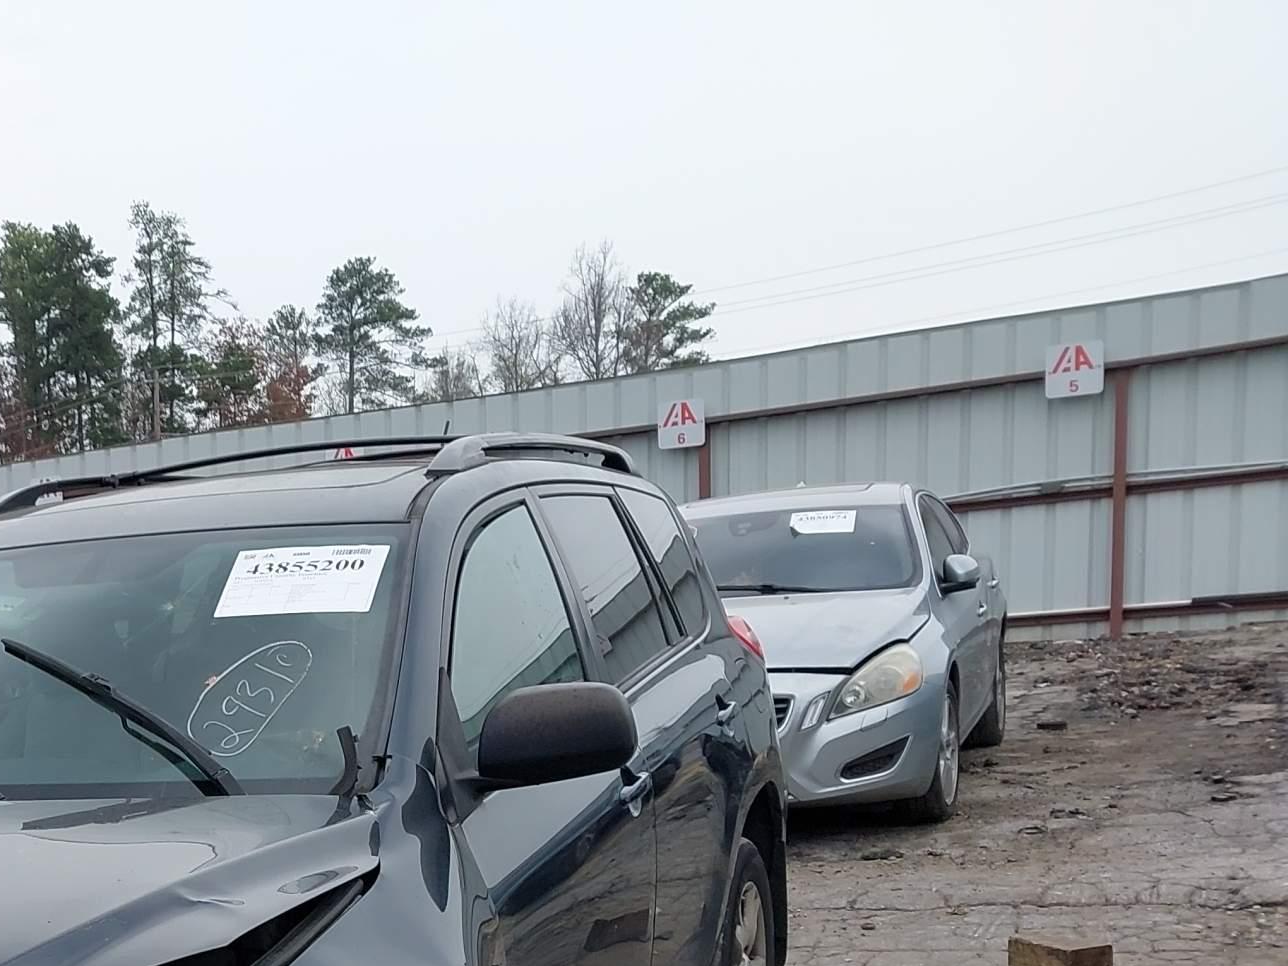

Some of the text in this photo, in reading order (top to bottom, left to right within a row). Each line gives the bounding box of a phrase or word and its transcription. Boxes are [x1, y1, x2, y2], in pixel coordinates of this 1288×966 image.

[1069, 379, 1080, 393] 5
[677, 432, 686, 445] 6
[246, 558, 365, 575] 43855200
